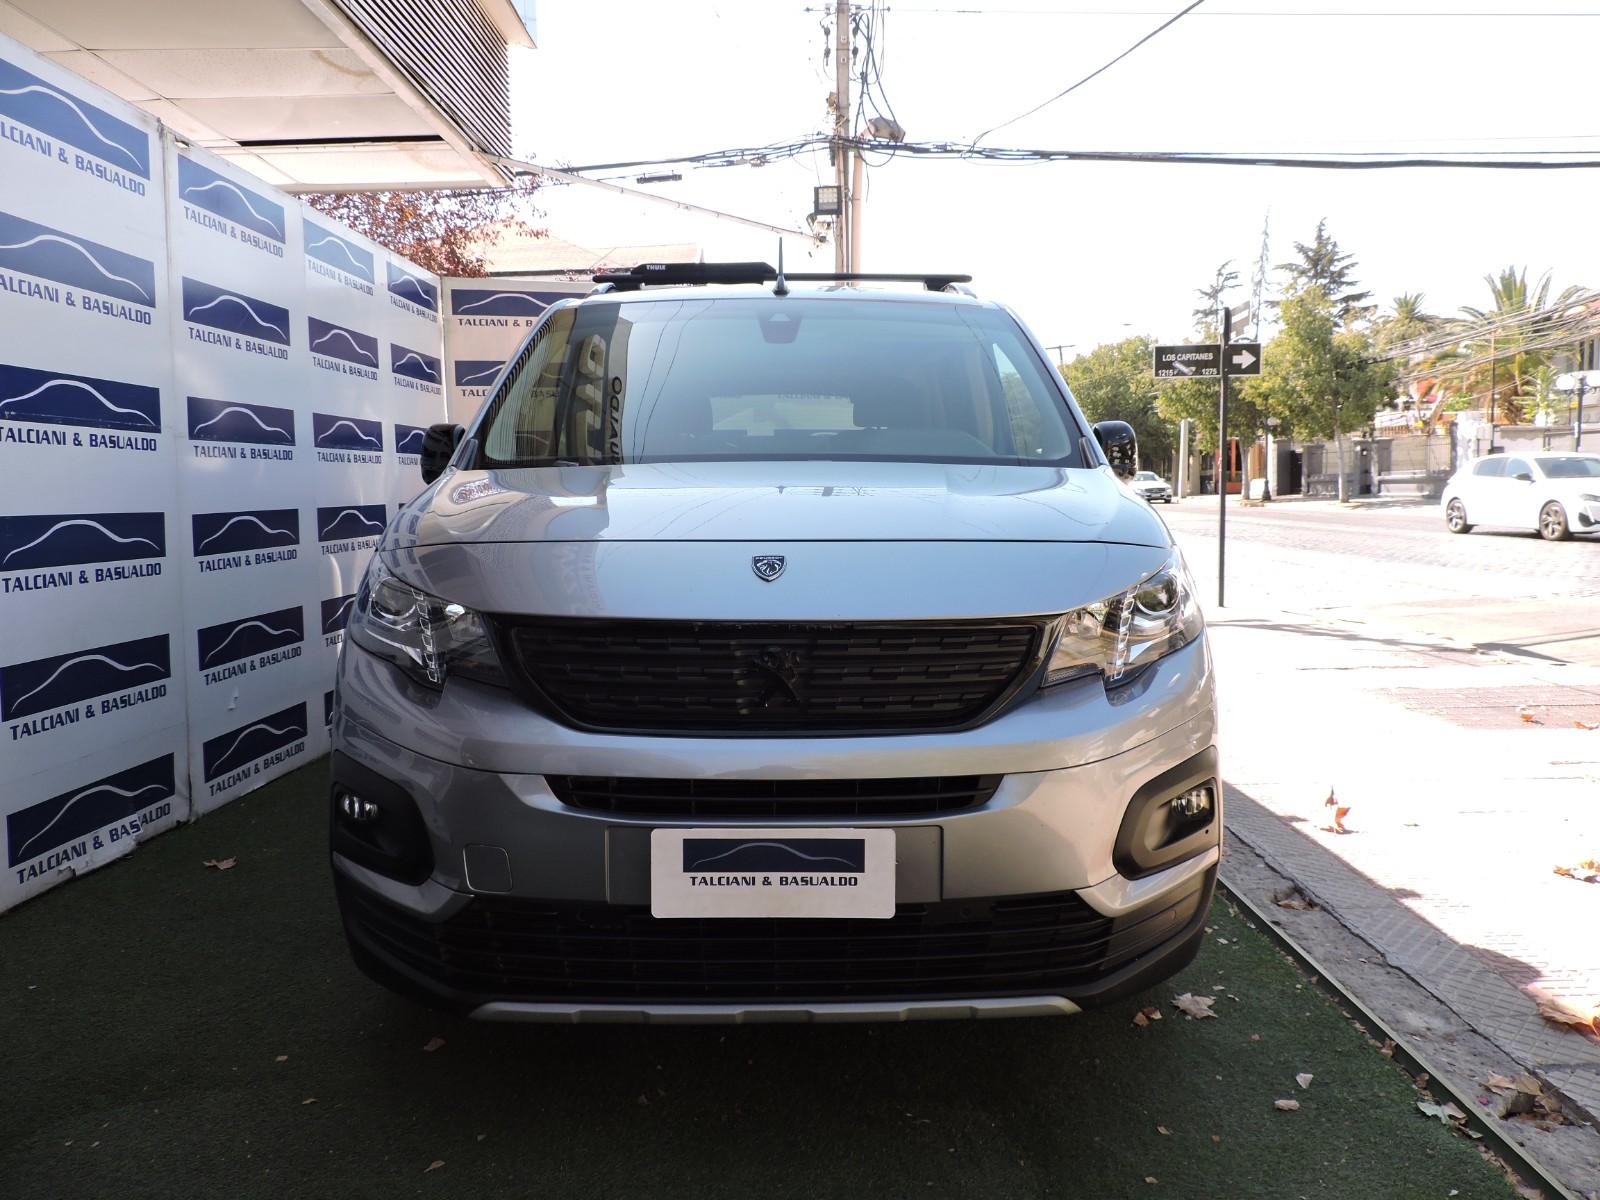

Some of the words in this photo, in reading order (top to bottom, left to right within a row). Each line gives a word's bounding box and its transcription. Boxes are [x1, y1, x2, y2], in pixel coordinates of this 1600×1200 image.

[1, 121, 51, 157] LCIANI
[58, 147, 69, 164] &
[75, 154, 146, 197] BASUALDO
[184, 206, 227, 235] TALCIANI
[230, 226, 237, 239] &
[240, 231, 283, 258] BASUALDO
[0, 274, 59, 303] ALCIANI
[66, 291, 76, 307] &
[82, 295, 151, 325] BASUALDO
[457, 318, 508, 327] TALCIANI
[512, 319, 520, 327] &
[188, 327, 231, 347] TALCIANI
[235, 338, 242, 350] &
[245, 340, 288, 360] BASUALDO
[1177, 352, 1214, 361] CAPITANES
[312, 357, 340, 373] TALCIANI
[342, 364, 347, 374] &
[349, 366, 378, 381] BASUALDO
[73, 433, 83, 446] &
[89, 433, 157, 451] BASUALDO
[194, 445, 237, 459] TALCIANI
[240, 448, 247, 459] &
[250, 448, 293, 461] BASUALDO
[198, 556, 242, 573] TALCIANI
[245, 555, 251, 566] &
[255, 549, 297, 565] BASUALDO
[2, 570, 73, 593] TALCIANI
[79, 569, 89, 584] &
[95, 562, 162, 583] BASUALDO
[204, 665, 247, 686] TALCIANI
[250, 660, 257, 671] &
[260, 646, 302, 668] BASUALDO
[10, 708, 80, 741] TALCIANI
[86, 704, 95, 719] &
[101, 684, 167, 714] BASUALDO
[209, 767, 250, 797] TALCIANI
[254, 763, 260, 775] &
[263, 741, 305, 770] BASUALDO
[16, 842, 87, 884] TALCIANI
[92, 835, 104, 850] &
[109, 802, 171, 843] BASALDO
[690, 876, 756, 886] TALCIANI
[762, 876, 773, 886] &
[779, 876, 858, 886] BASUALDO
